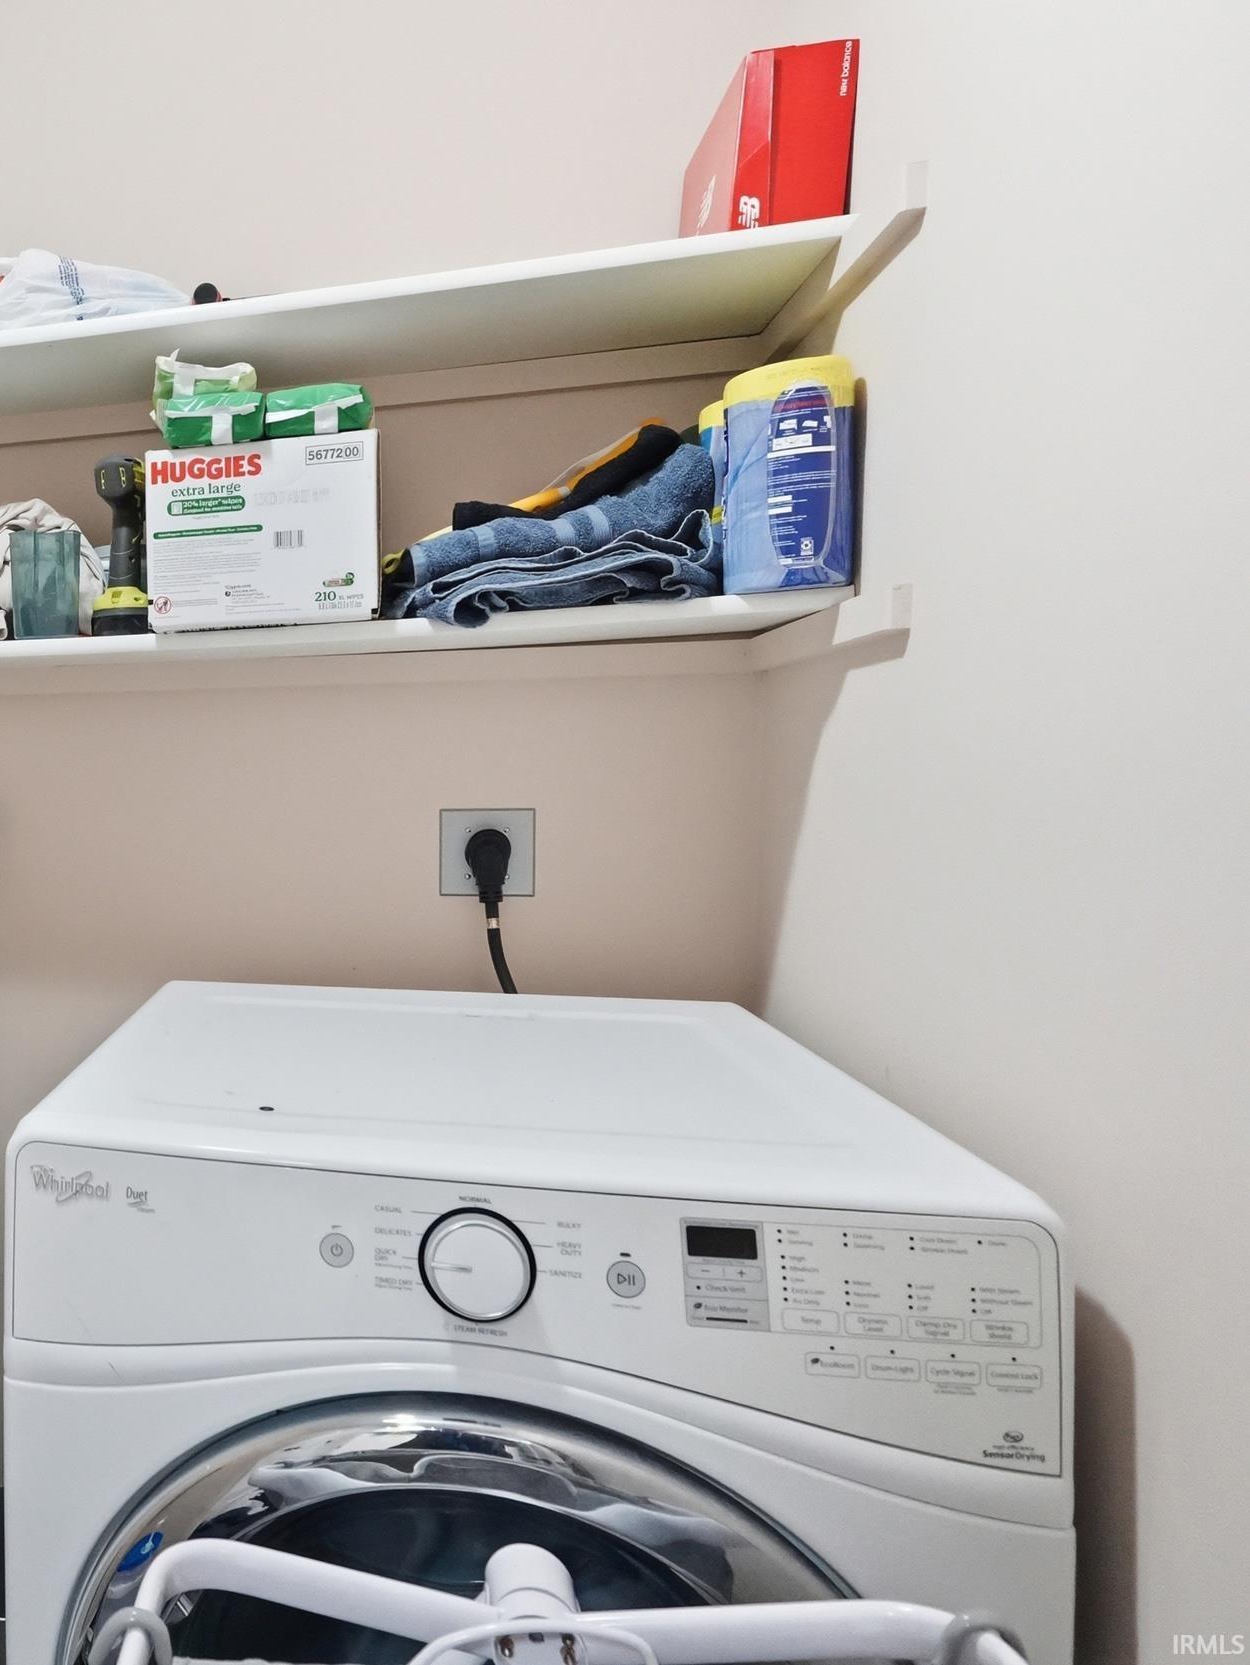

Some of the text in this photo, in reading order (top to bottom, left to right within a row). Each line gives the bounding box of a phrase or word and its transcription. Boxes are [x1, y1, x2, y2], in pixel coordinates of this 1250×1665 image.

[839, 40, 853, 97] new balance
[307, 446, 360, 461] 5677200
[150, 453, 262, 485] HUGGIES
[171, 482, 242, 498] extra large
[314, 590, 337, 602] 210
[31, 1167, 110, 1202] Whirlpool
[125, 1186, 148, 1201] Duet
[458, 1195, 492, 1205] NORMAL
[374, 1204, 402, 1214] CASUAL
[557, 1221, 582, 1230] BULKY
[374, 1227, 412, 1238] DELICATES
[557, 1241, 582, 1250] HEAVY
[374, 1248, 398, 1257] QUICK
[560, 1249, 582, 1257] DUTY
[549, 1269, 583, 1280] SANITIZE
[374, 1276, 414, 1286] TIMED DRY
[705, 1283, 727, 1294] Check
[719, 1305, 749, 1315] Monitor
[857, 1316, 889, 1326] Dryness
[914, 1319, 959, 1331] Damp Dry
[454, 1324, 508, 1337] STEAM REFRESH
[863, 1324, 885, 1334] Level
[924, 1328, 951, 1338] Signal
[984, 1323, 1014, 1333] Wrinkle
[987, 1330, 1013, 1341] Shield
[930, 1367, 976, 1379] Cycle Signal
[990, 1370, 1040, 1382] Control Lock
[982, 1449, 1047, 1463] SensorDrying
